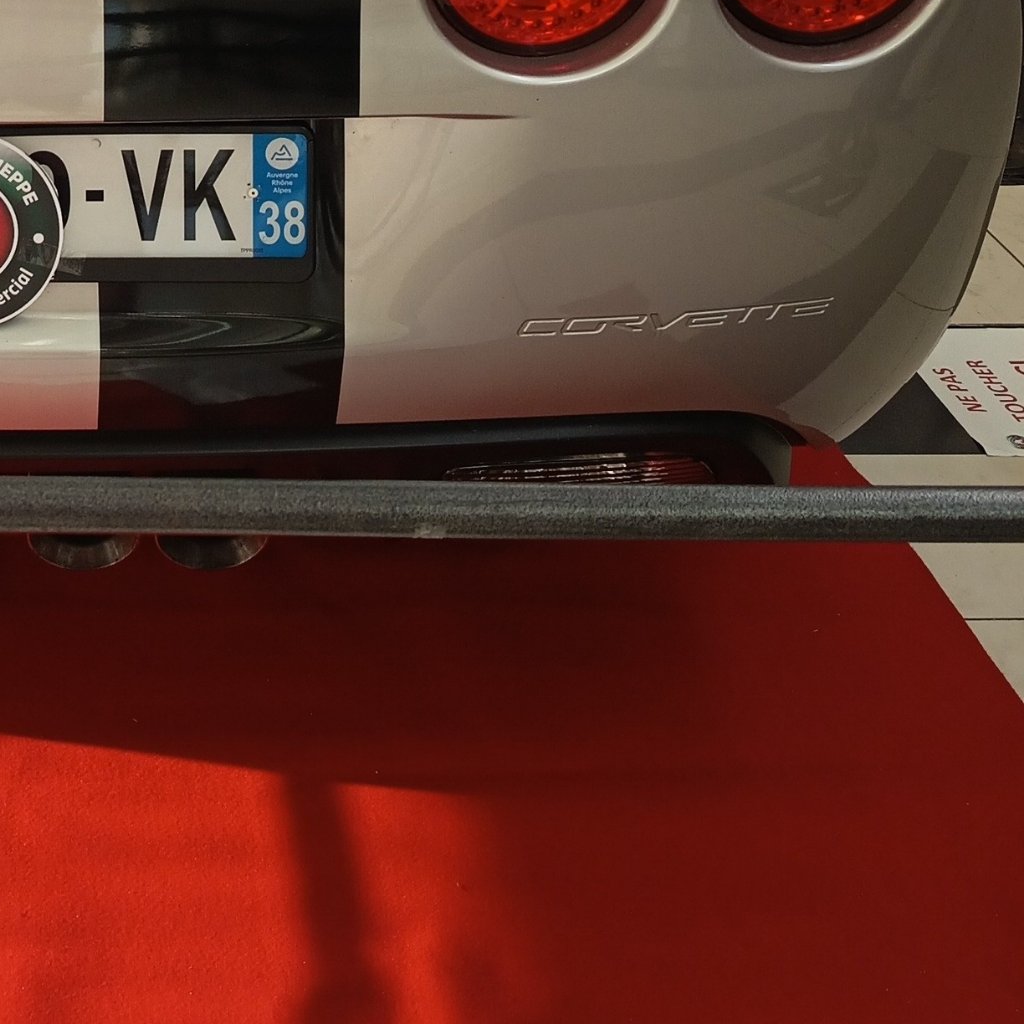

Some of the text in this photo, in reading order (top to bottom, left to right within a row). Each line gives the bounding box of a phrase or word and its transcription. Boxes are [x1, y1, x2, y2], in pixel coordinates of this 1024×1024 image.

[266, 172, 299, 180] Auvergne
[273, 187, 292, 195] Alpes
[259, 200, 306, 245] 38
[517, 296, 835, 337] CORVETTE
[932, 367, 987, 413] NE PAS
[966, 360, 1024, 423] TOUCHER
